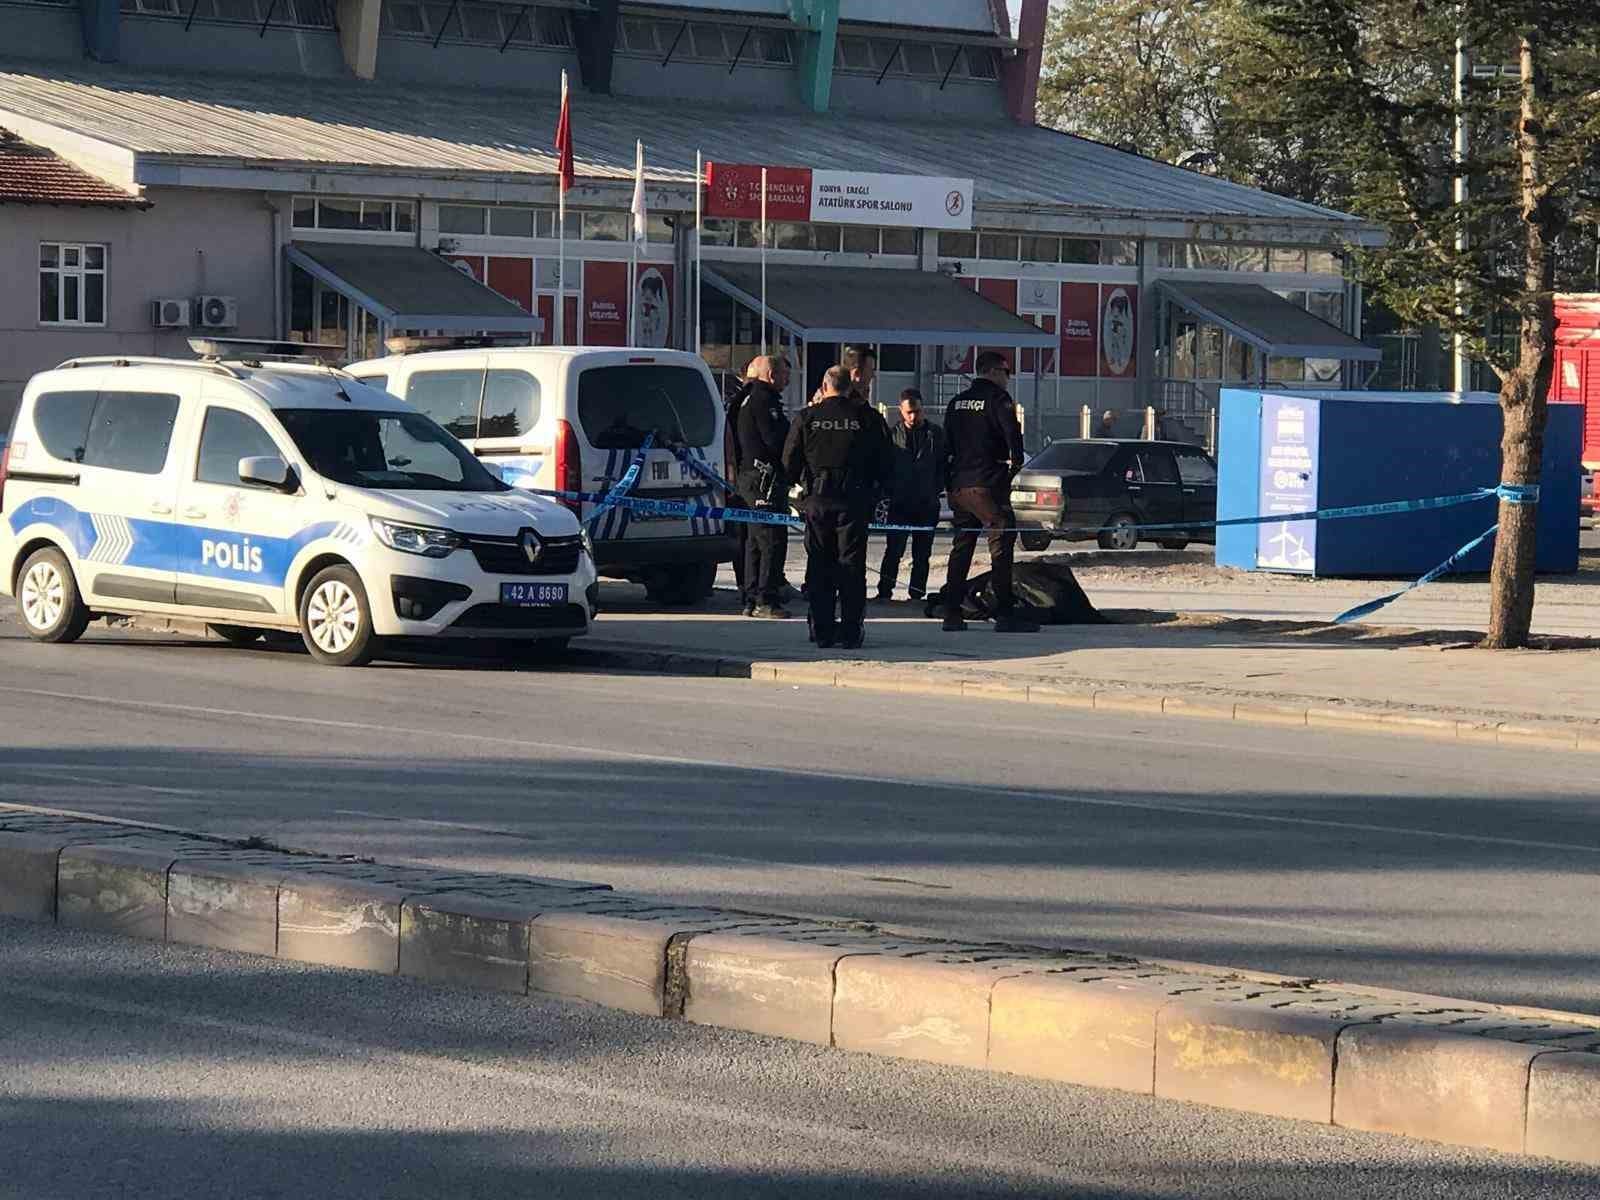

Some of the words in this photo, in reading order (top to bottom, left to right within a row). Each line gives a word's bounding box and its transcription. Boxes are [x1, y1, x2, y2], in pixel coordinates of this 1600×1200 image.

[819, 185, 841, 193] KONYA
[818, 196, 856, 209] ATATÜRK
[857, 199, 880, 210] SPOR
[880, 200, 913, 212] SALONU
[810, 417, 861, 430] POLİS
[202, 537, 263, 573] POLİS
[511, 585, 524, 600] 42
[527, 586, 535, 600] A
